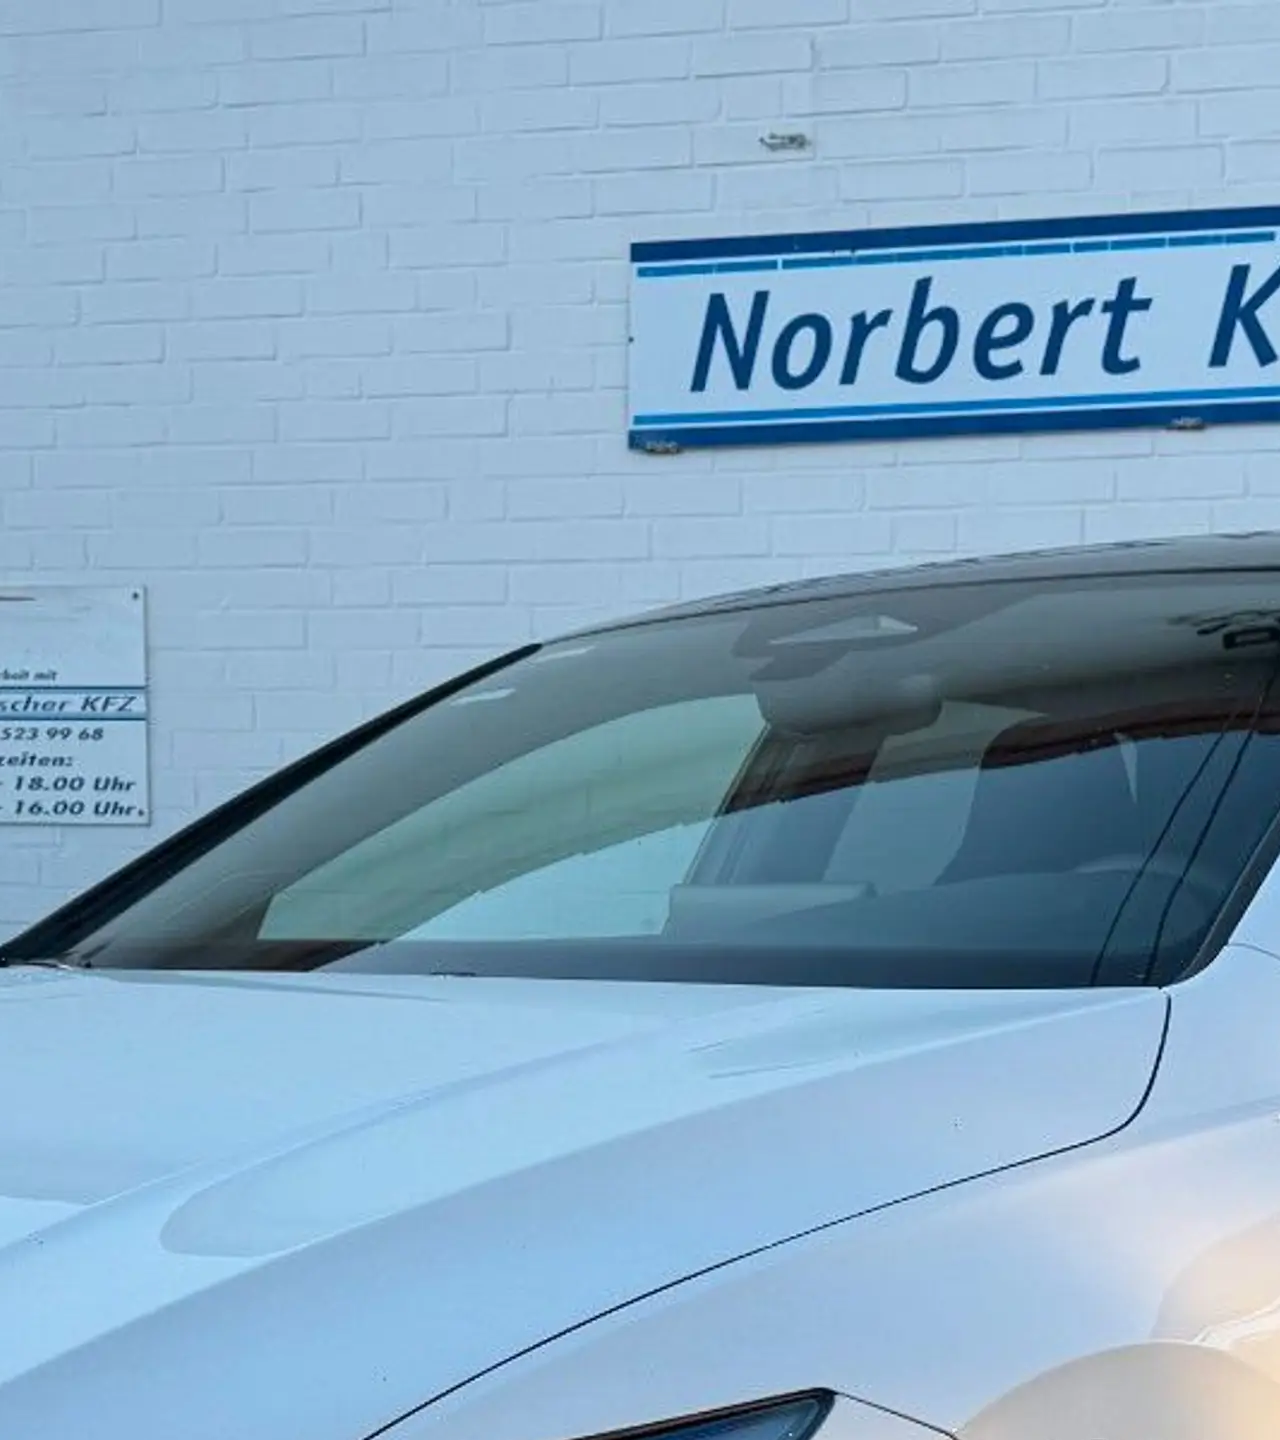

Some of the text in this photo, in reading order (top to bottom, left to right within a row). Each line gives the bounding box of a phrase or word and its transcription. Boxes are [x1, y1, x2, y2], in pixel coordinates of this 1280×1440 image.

[690, 275, 1153, 393] Norbert
[33, 669, 59, 682] mit
[80, 695, 138, 712] KFZ
[0, 726, 39, 742] 523
[45, 727, 73, 743] 99
[77, 727, 104, 742] 68
[14, 776, 85, 792] 18.00
[93, 776, 136, 792] Uhr
[14, 800, 85, 816] 16.00
[93, 801, 134, 817] Uhr
